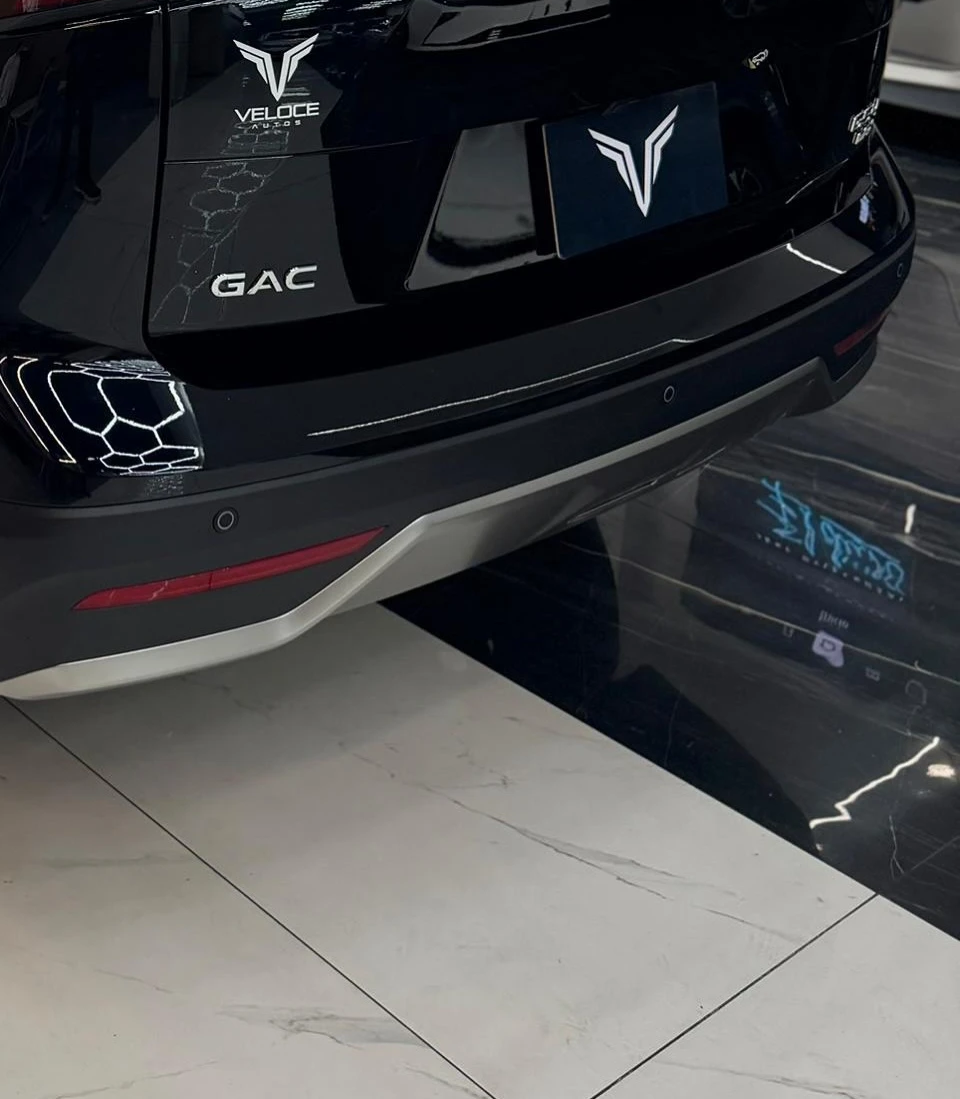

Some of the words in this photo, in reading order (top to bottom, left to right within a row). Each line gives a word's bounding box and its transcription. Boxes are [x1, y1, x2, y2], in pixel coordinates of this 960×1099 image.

[234, 102, 320, 123] VELOCE
[251, 119, 301, 130] AUTOS
[211, 265, 318, 298] GAC
